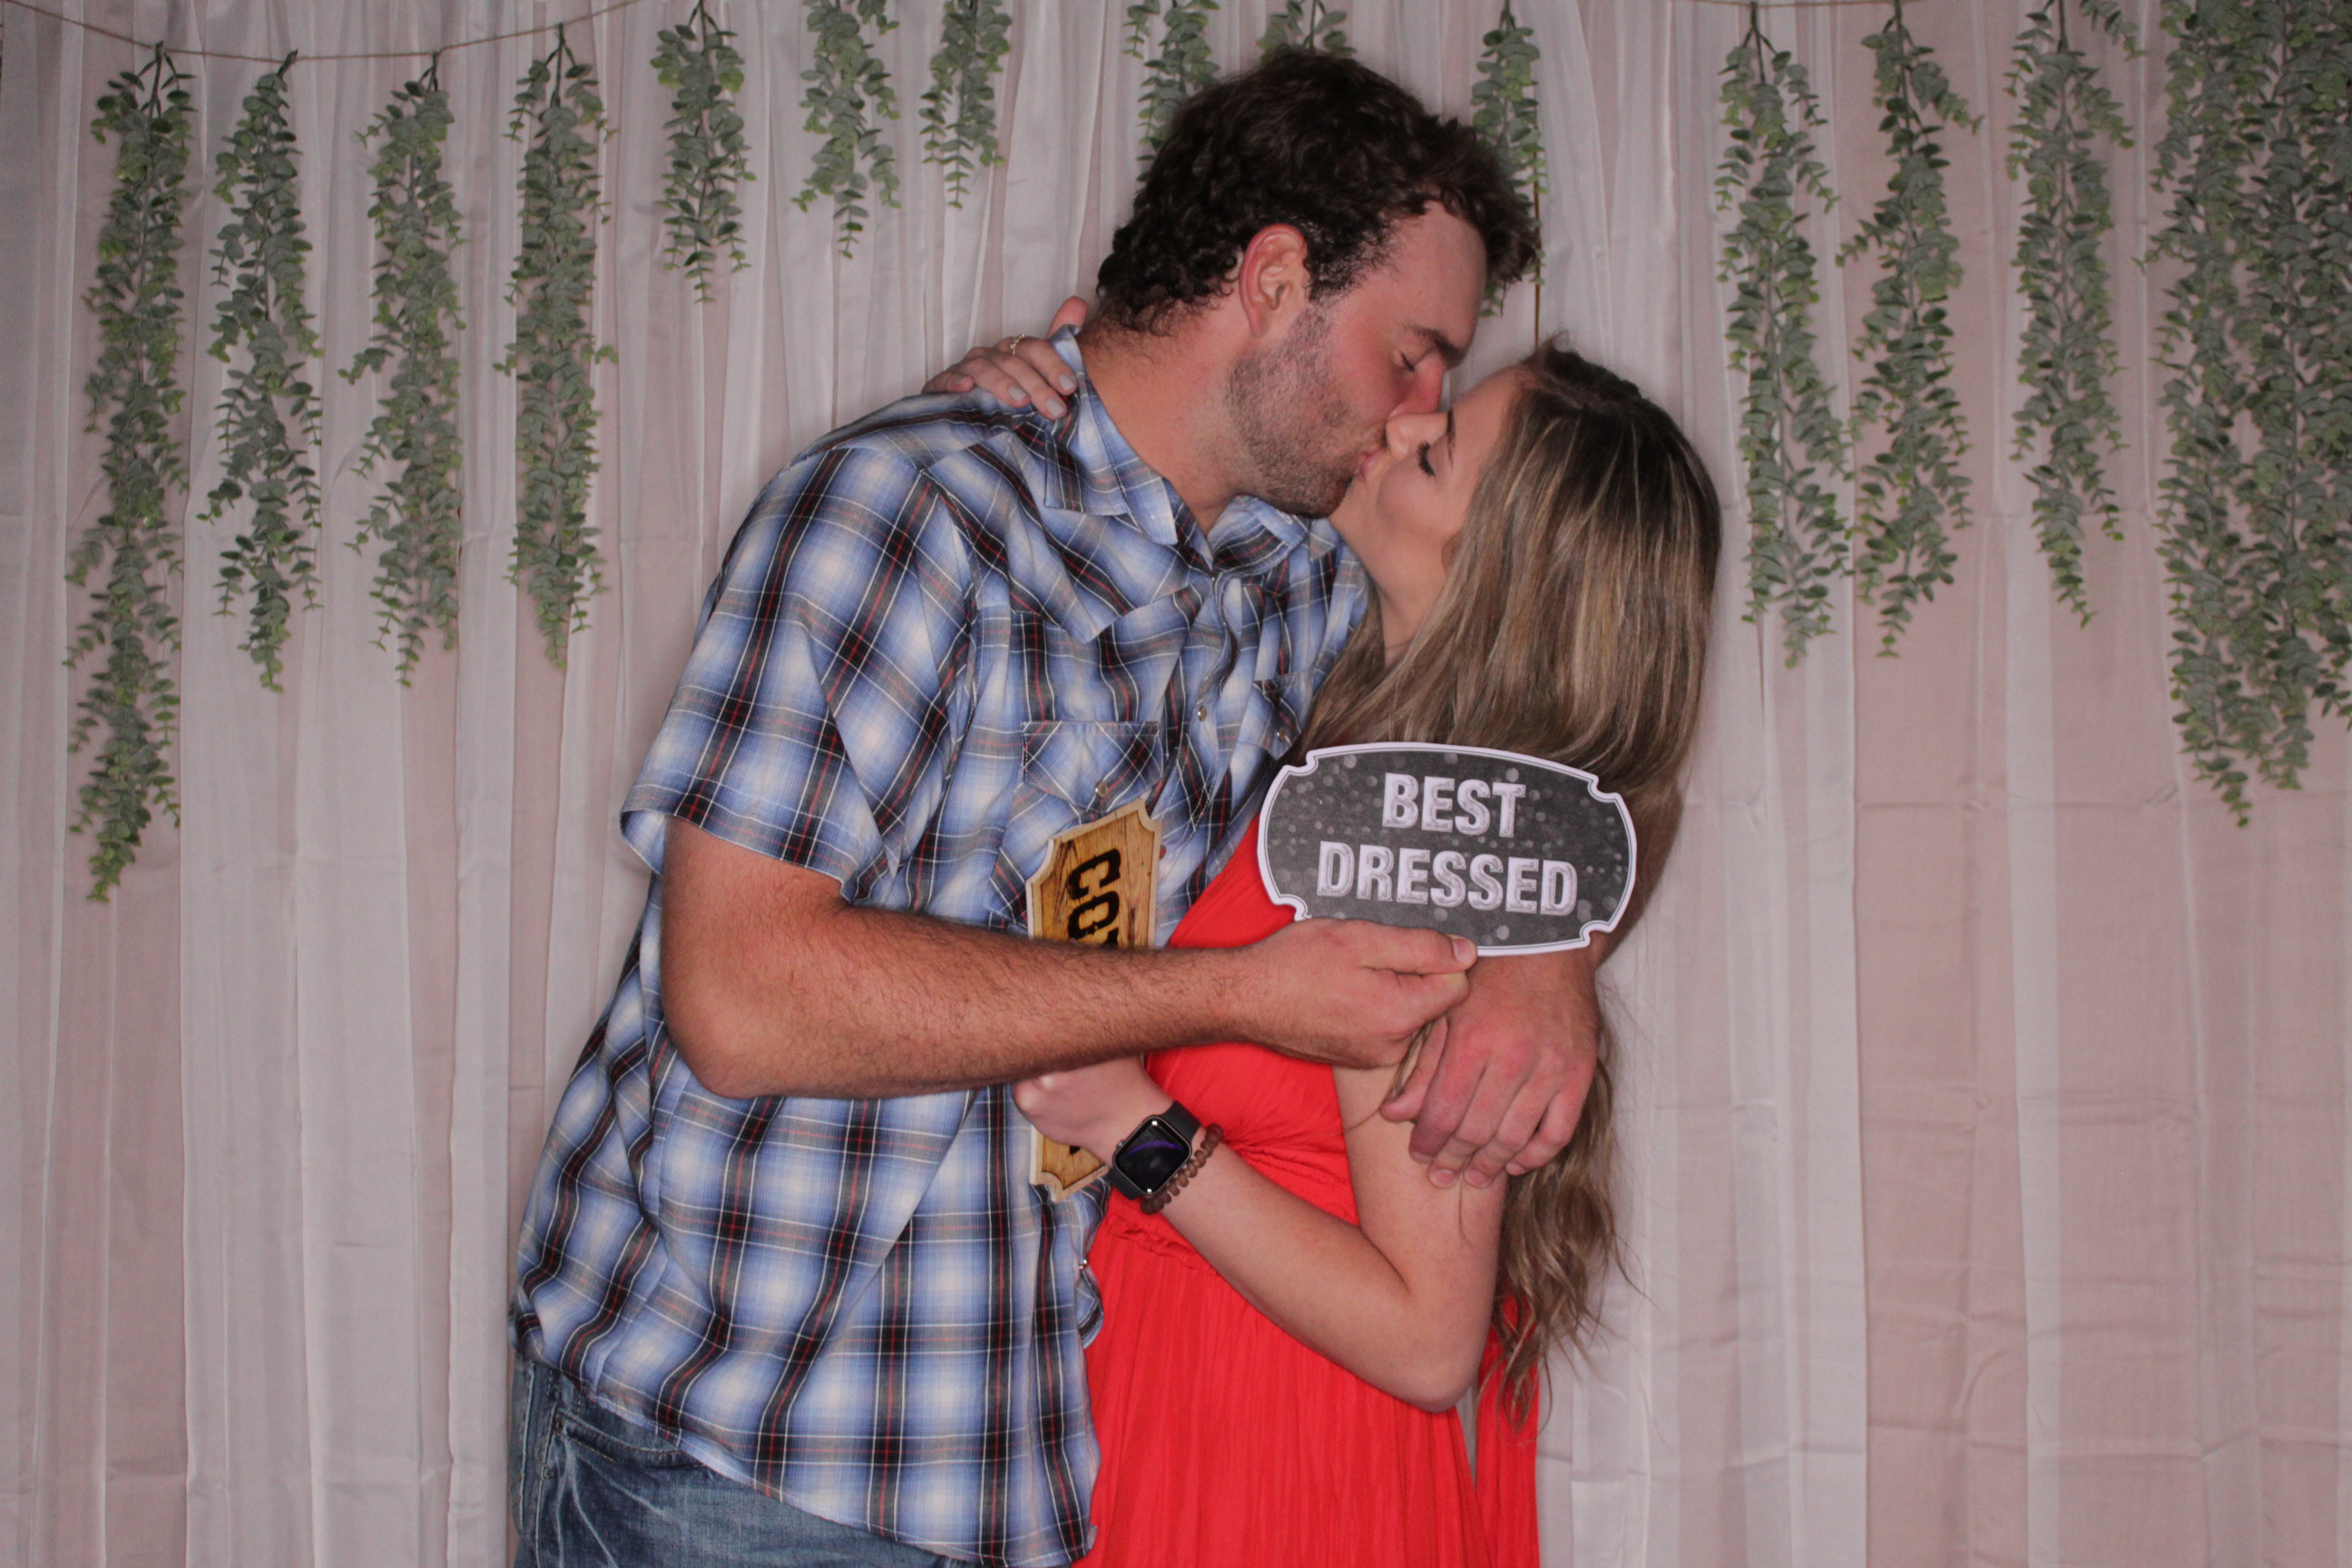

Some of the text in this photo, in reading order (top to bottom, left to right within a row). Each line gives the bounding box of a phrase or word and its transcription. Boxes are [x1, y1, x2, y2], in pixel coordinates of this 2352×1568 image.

[1382, 772, 1526, 838] BEST
[1067, 848, 1122, 948] CO
[1317, 840, 1578, 916] DRESSED
